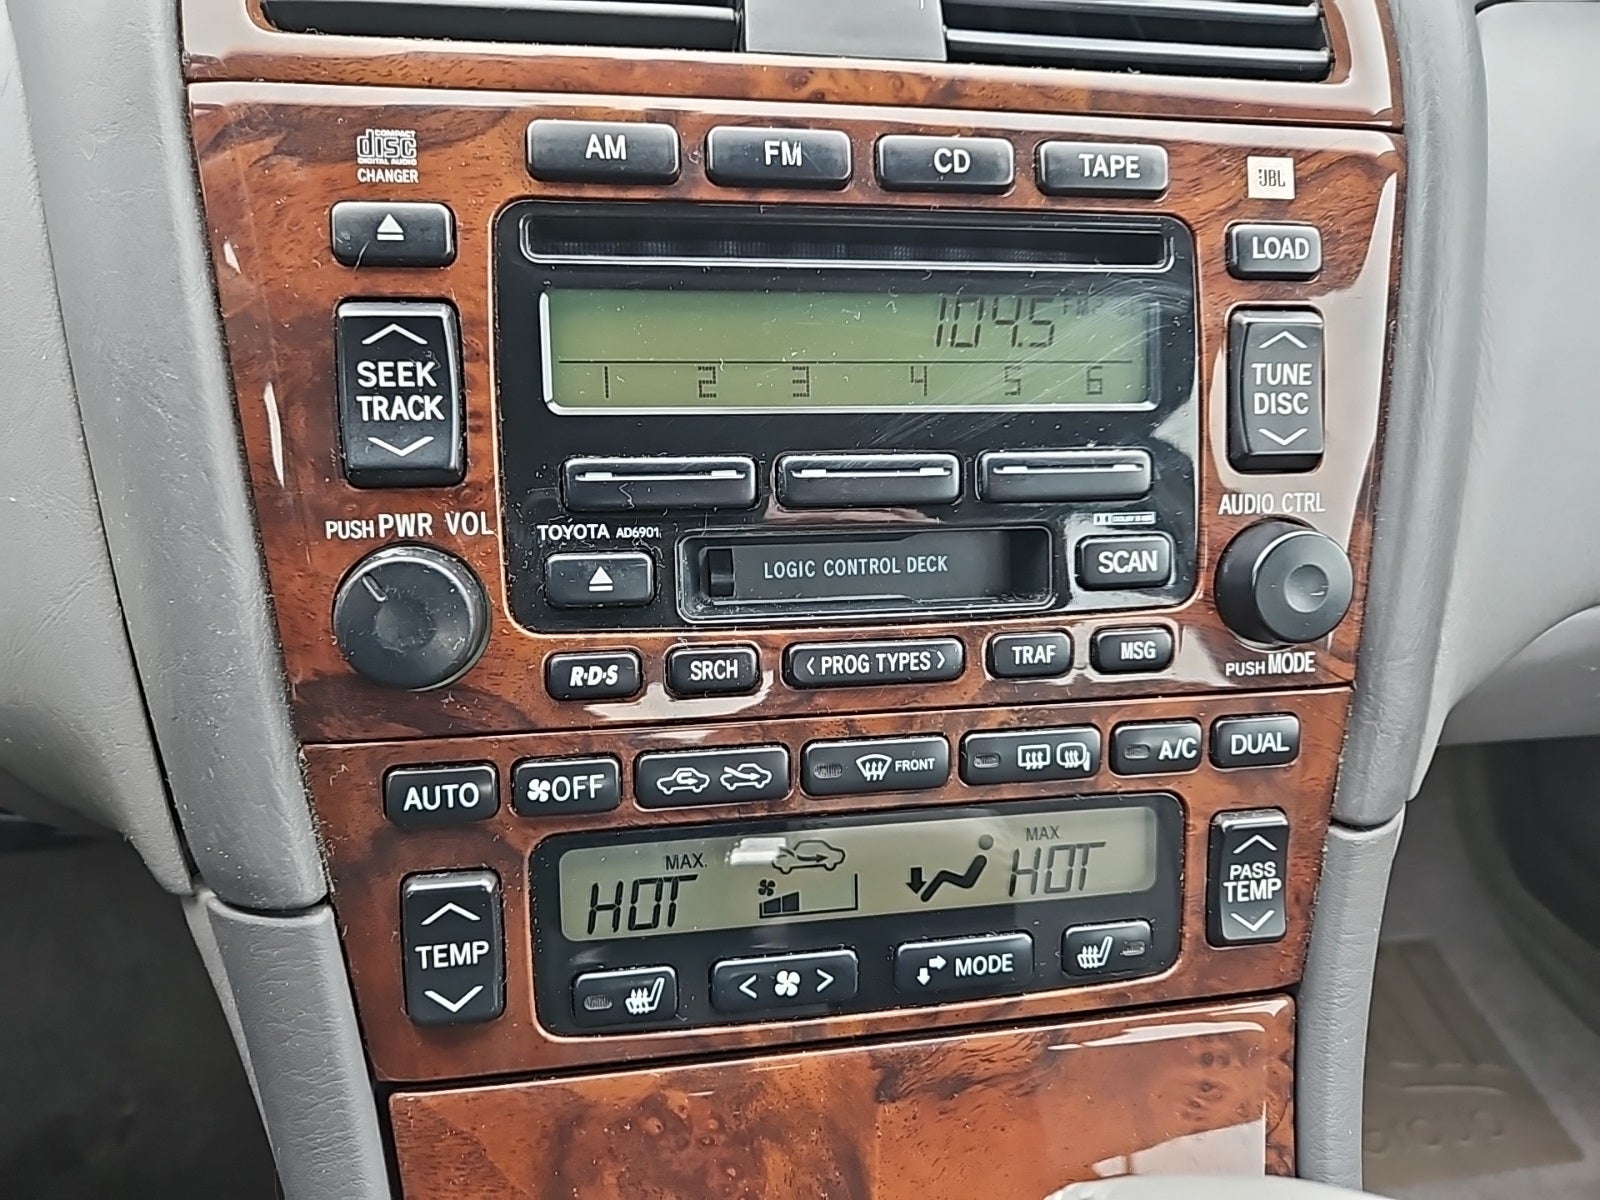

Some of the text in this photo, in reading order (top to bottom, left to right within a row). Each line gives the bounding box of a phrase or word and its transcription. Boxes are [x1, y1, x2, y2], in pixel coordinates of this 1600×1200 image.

[375, 129, 416, 138] COMPACT
[585, 133, 627, 161] AM
[764, 140, 803, 166] FM
[357, 157, 418, 166] DIGITAL AUDIO
[933, 148, 971, 174] CD
[1079, 153, 1141, 179] TAPE
[357, 168, 419, 183] CHANGER
[1258, 168, 1286, 187] JBL
[1252, 236, 1310, 261] LOAD
[935, 294, 1055, 349] 104.5
[357, 361, 437, 389] SEEK
[697, 365, 718, 399] 2
[791, 365, 812, 399] 3
[910, 365, 930, 397] 4
[1004, 365, 1022, 396] 5
[1086, 365, 1103, 395] 6
[1251, 363, 1313, 387] TUNE
[356, 394, 445, 422] TRACK
[1253, 392, 1310, 416] DISC
[1218, 491, 1326, 515] AUDIO CTRL
[325, 511, 496, 539] PUSH PWR VOL
[537, 523, 661, 540] TOYOTA AD6901
[763, 555, 949, 579] LOGIC CONTROL DECK
[1098, 549, 1158, 574] SCAN
[821, 651, 932, 676] PROG TYPES
[1011, 645, 1057, 666] TRAF
[1120, 640, 1157, 662] MSG
[689, 658, 738, 681] SRCH
[1225, 651, 1317, 677] PUSH MODE
[1158, 736, 1198, 762] A/C
[1230, 731, 1291, 756] DUAL
[894, 756, 936, 773] FRONT
[403, 780, 480, 811] AUTO
[551, 773, 606, 801] OFF
[1008, 841, 1107, 898] HOT
[1229, 861, 1276, 880] PASS
[1223, 877, 1283, 903] TEMP
[586, 873, 698, 936] HOT
[414, 939, 490, 970] TEMP
[954, 952, 1014, 979] MODE
